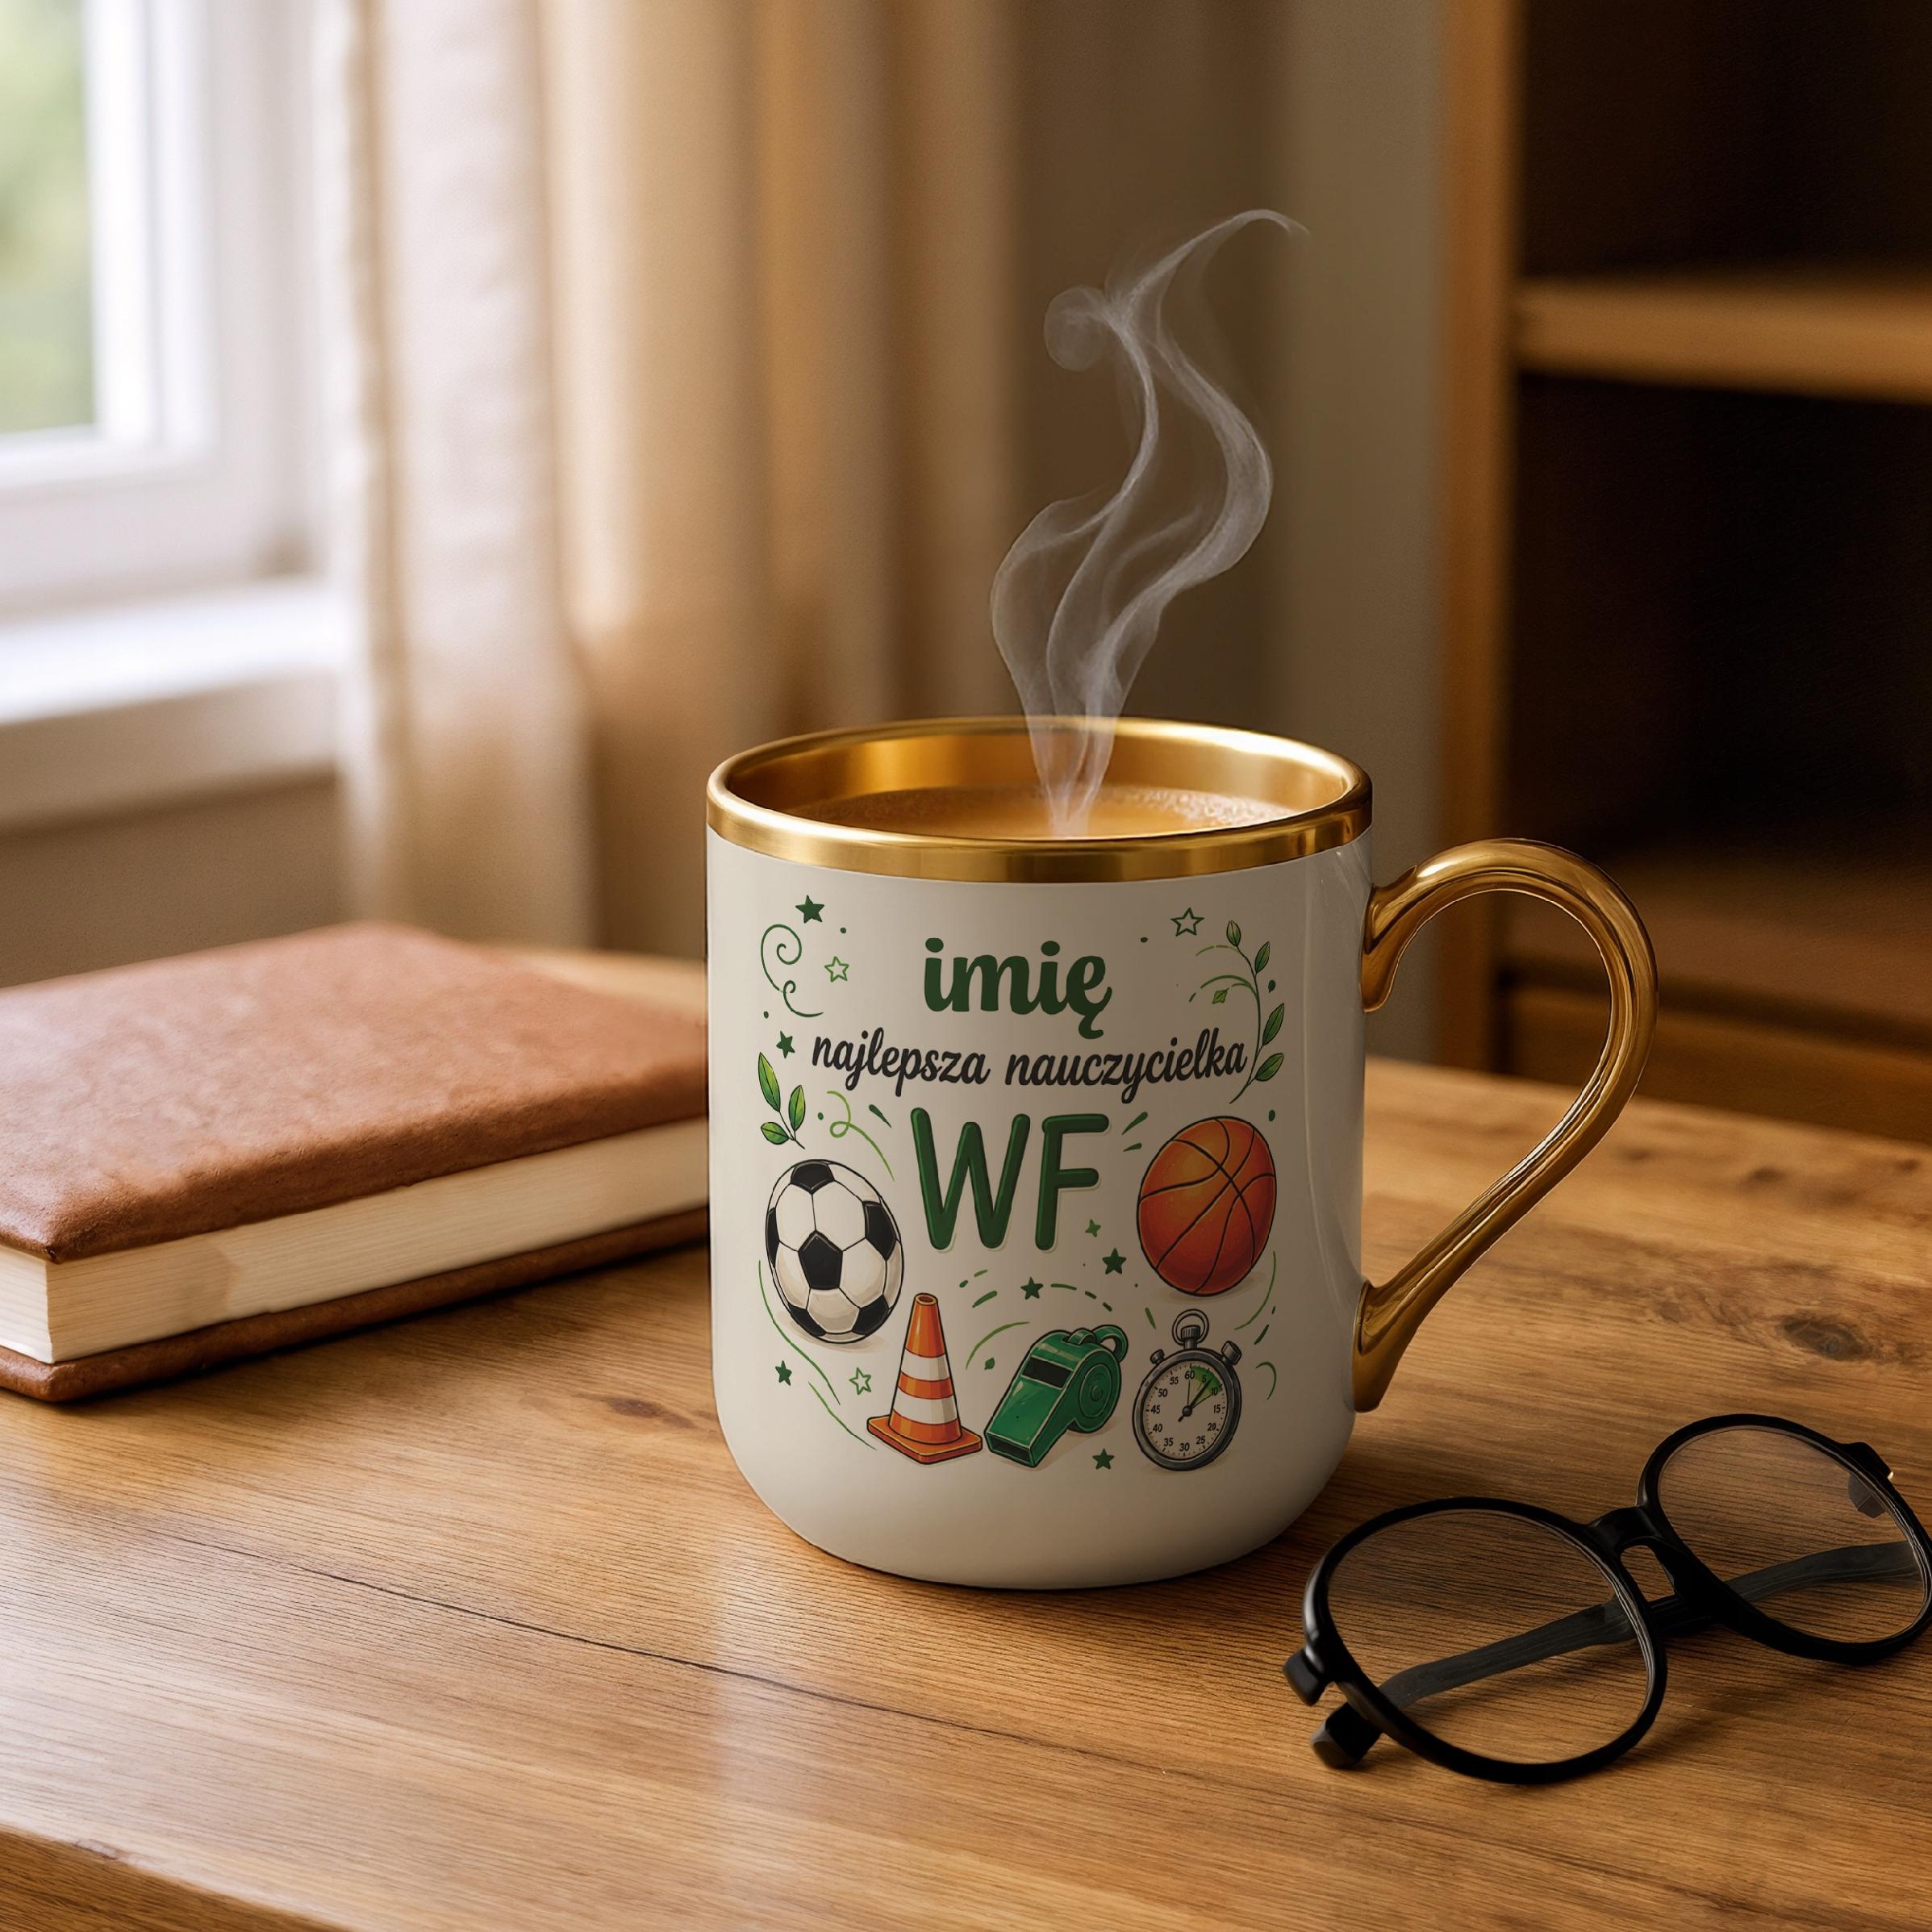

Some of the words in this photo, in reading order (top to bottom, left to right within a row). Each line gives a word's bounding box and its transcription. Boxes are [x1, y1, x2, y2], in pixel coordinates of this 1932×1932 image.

[924, 938, 1112, 1040] imię
[812, 1028, 991, 1098] najlepsza
[1005, 1028, 1249, 1104] nauczycielka
[911, 1108, 1111, 1251] WF
[1185, 1371, 1195, 1379] 60
[1170, 1376, 1179, 1385] 55
[1158, 1388, 1168, 1397] 50
[1211, 1387, 1218, 1396] 10
[1150, 1404, 1161, 1414] 45
[1213, 1404, 1221, 1413] 15
[1153, 1423, 1162, 1432] 40
[1207, 1422, 1216, 1431] 20
[1163, 1438, 1173, 1446] 35
[1196, 1436, 1206, 1445] 25
[1179, 1442, 1190, 1451] 30
